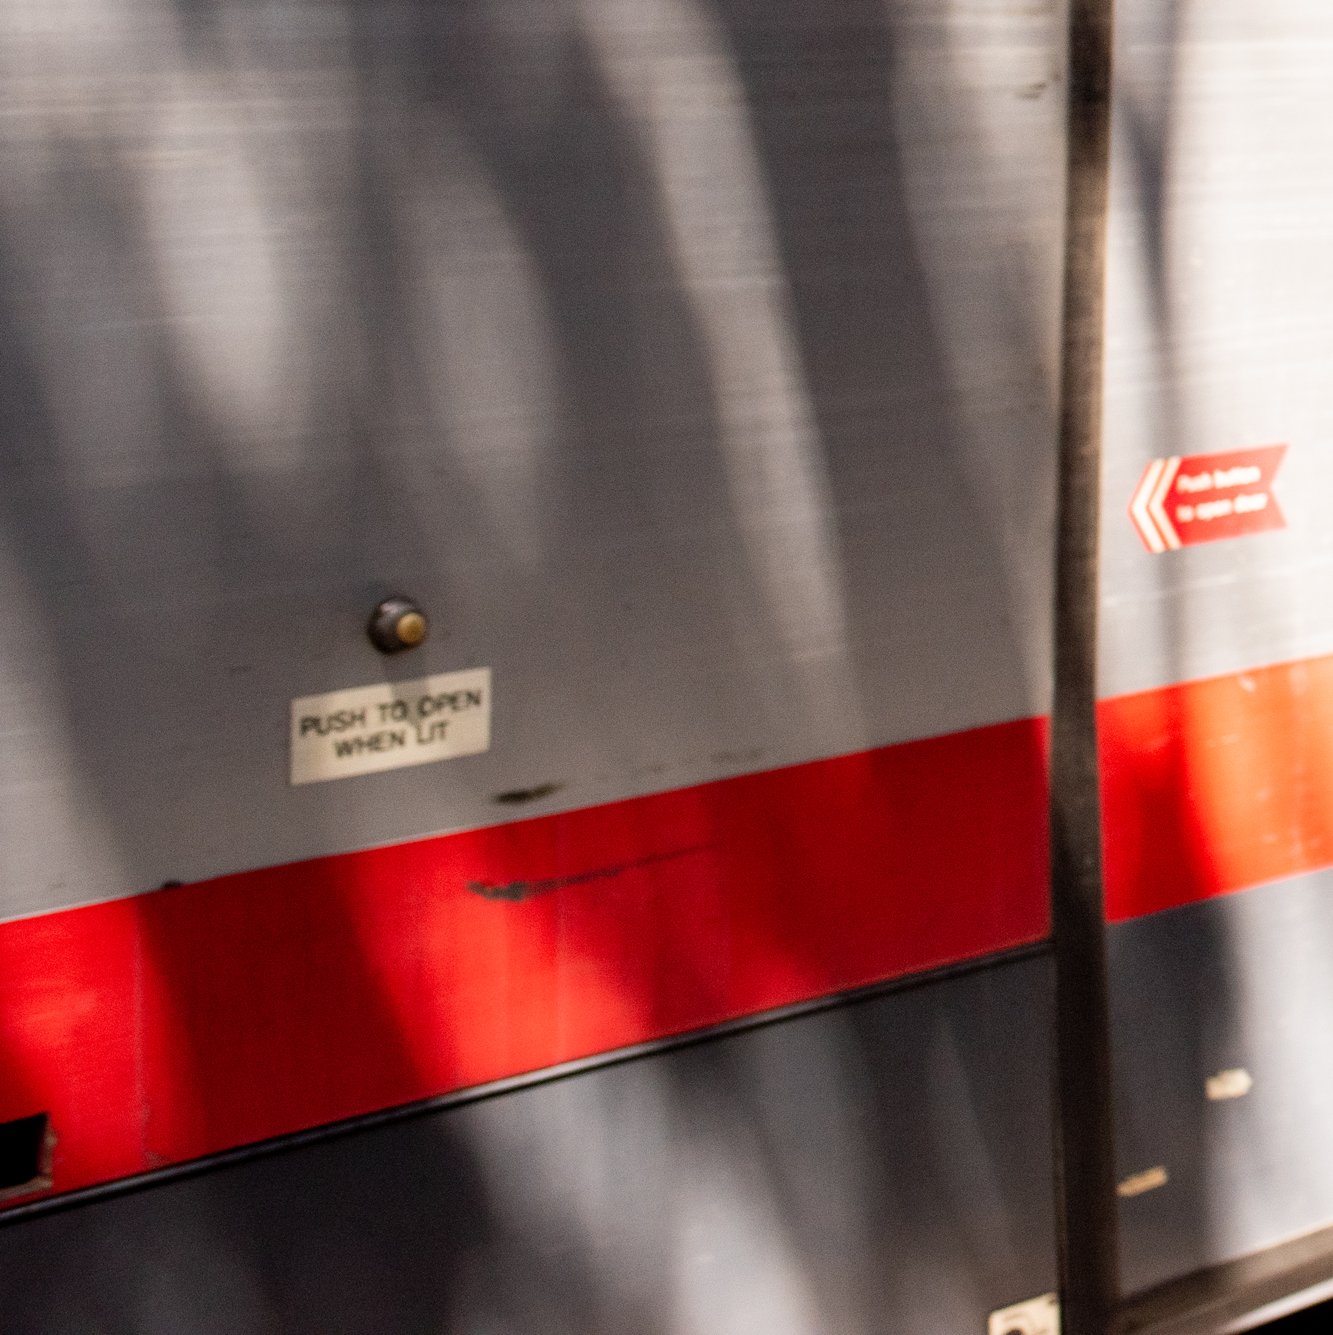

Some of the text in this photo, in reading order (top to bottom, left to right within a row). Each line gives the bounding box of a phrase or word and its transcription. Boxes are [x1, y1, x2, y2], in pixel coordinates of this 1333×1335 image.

[1176, 465, 1261, 494] Push button
[299, 689, 482, 738] PUSH TO OPEN
[334, 720, 449, 759] WHEN LIT
